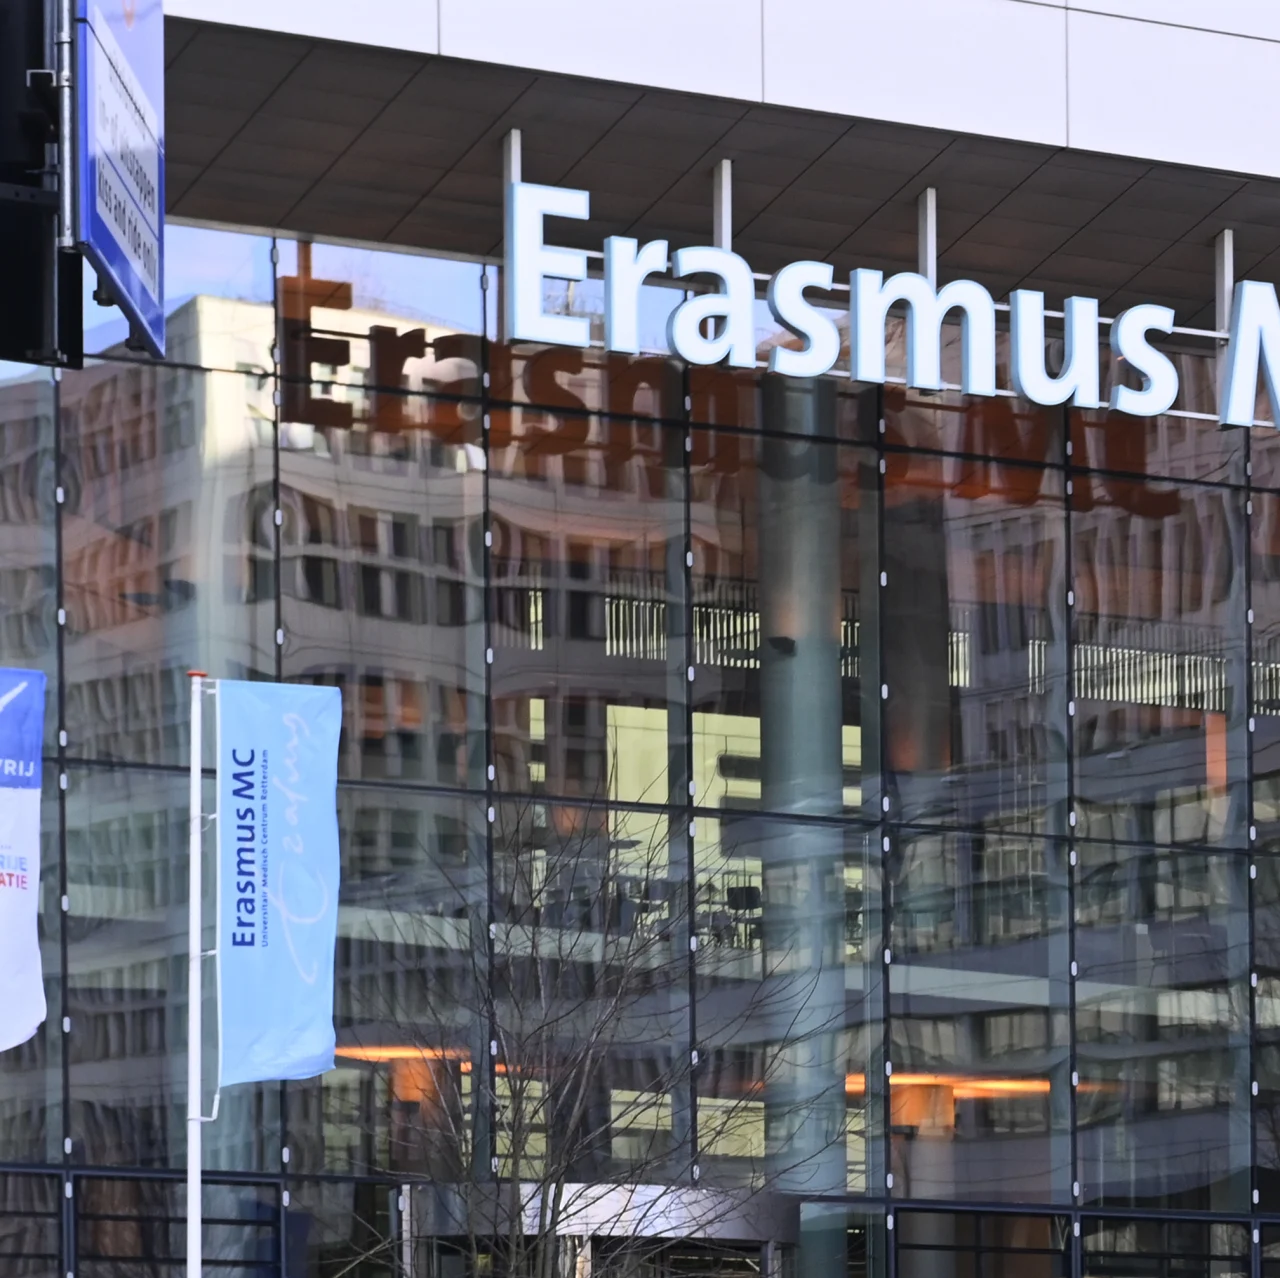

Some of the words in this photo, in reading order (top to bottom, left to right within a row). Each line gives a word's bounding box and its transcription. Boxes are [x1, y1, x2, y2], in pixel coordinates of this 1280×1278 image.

[508, 181, 1180, 418] Erasmus
[232, 748, 256, 801] MC
[232, 805, 256, 947] Erasmus
[260, 848, 269, 888] Medisch
